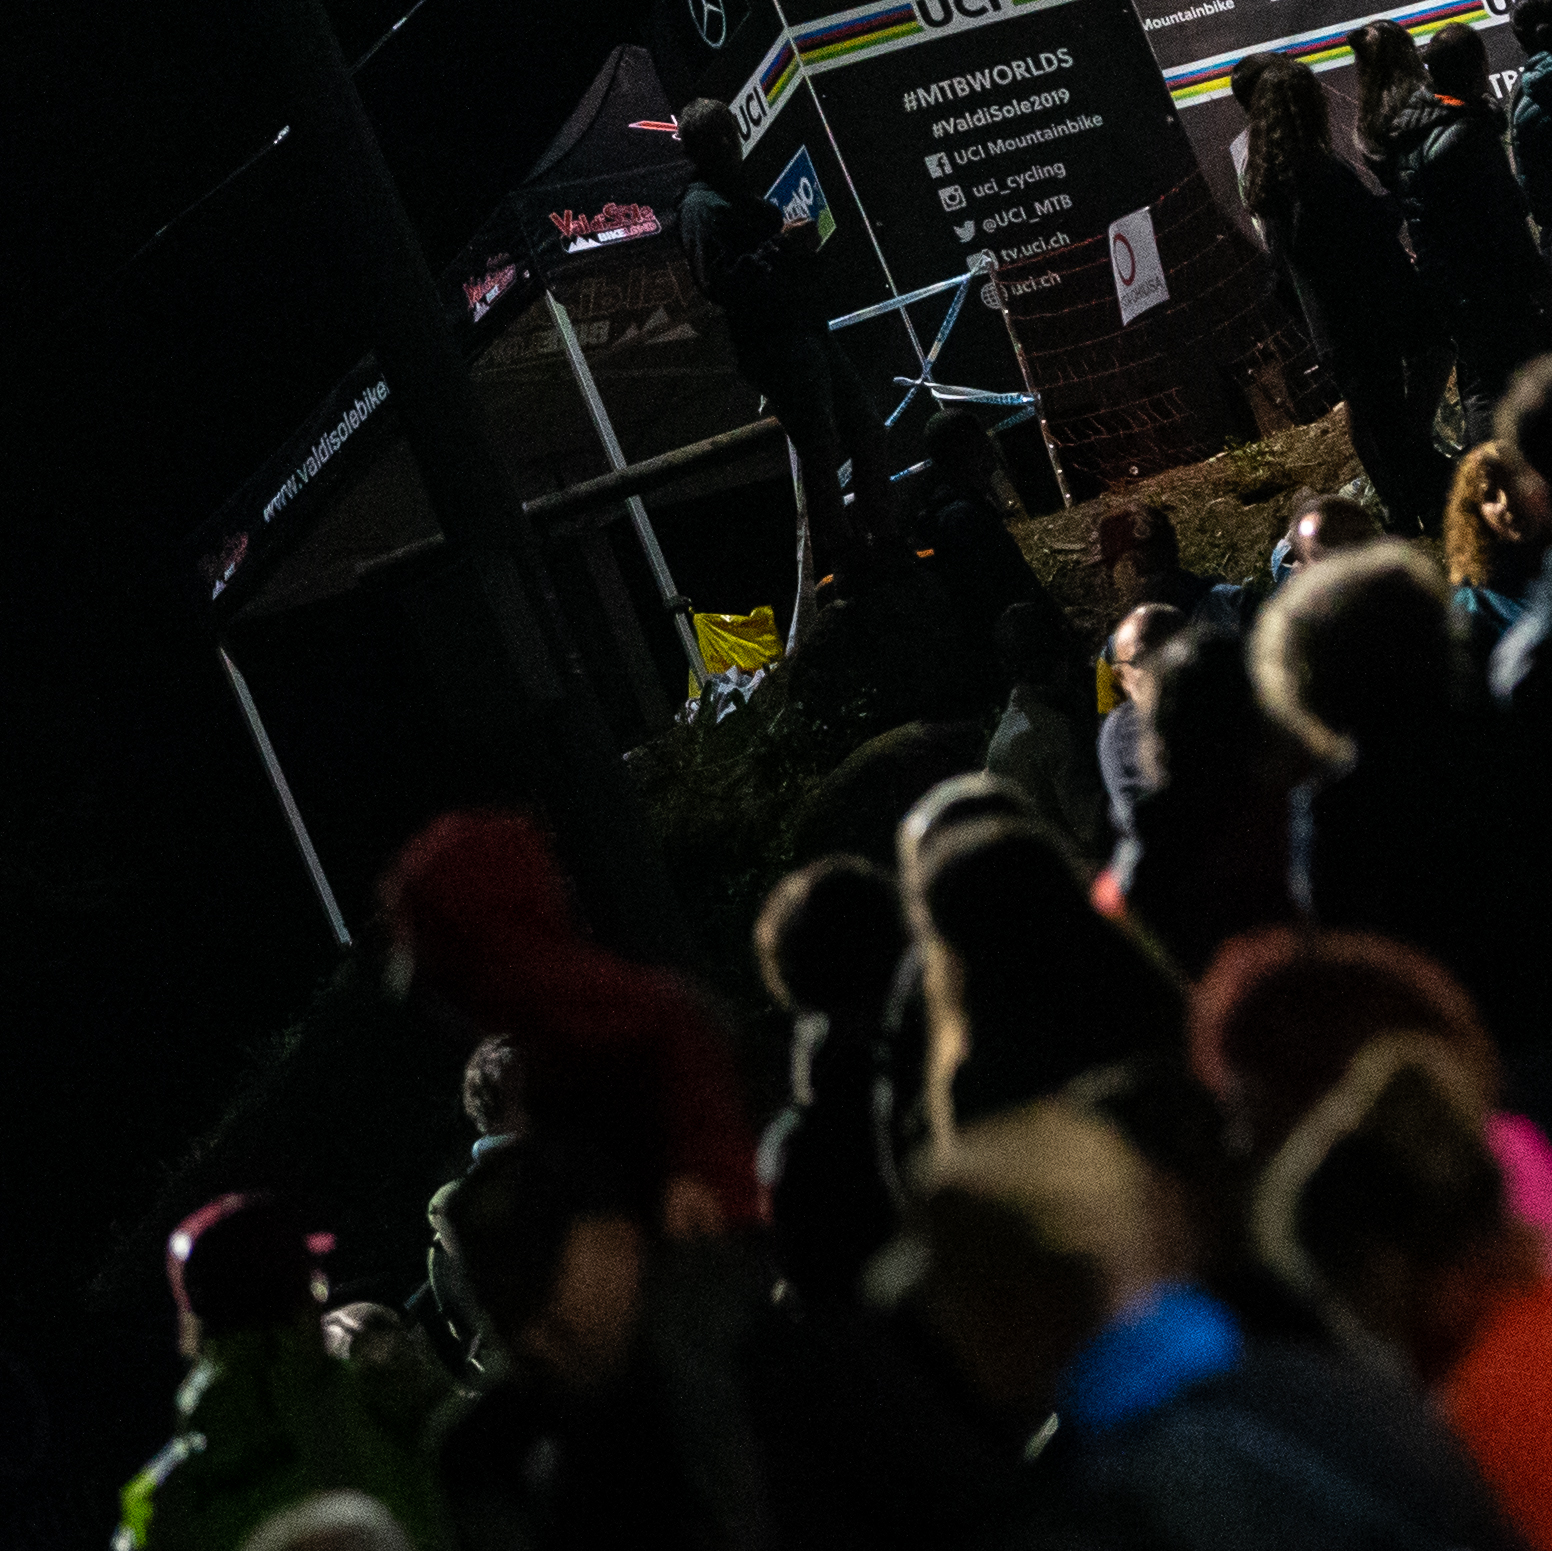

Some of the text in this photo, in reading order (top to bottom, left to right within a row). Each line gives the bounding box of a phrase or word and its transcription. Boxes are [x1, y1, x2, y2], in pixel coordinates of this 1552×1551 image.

[903, 47, 1074, 112] #MTBWORLDS
[736, 85, 768, 139] UCI
[931, 88, 1071, 139] #ValdiSole2019
[954, 112, 1104, 166] UCI Mountainbike
[973, 161, 1067, 199] uci_cycling
[982, 193, 1073, 234] @UCI_MTB
[1000, 232, 1071, 262] tv.uci.ch
[1011, 271, 1062, 296] uci.ch
